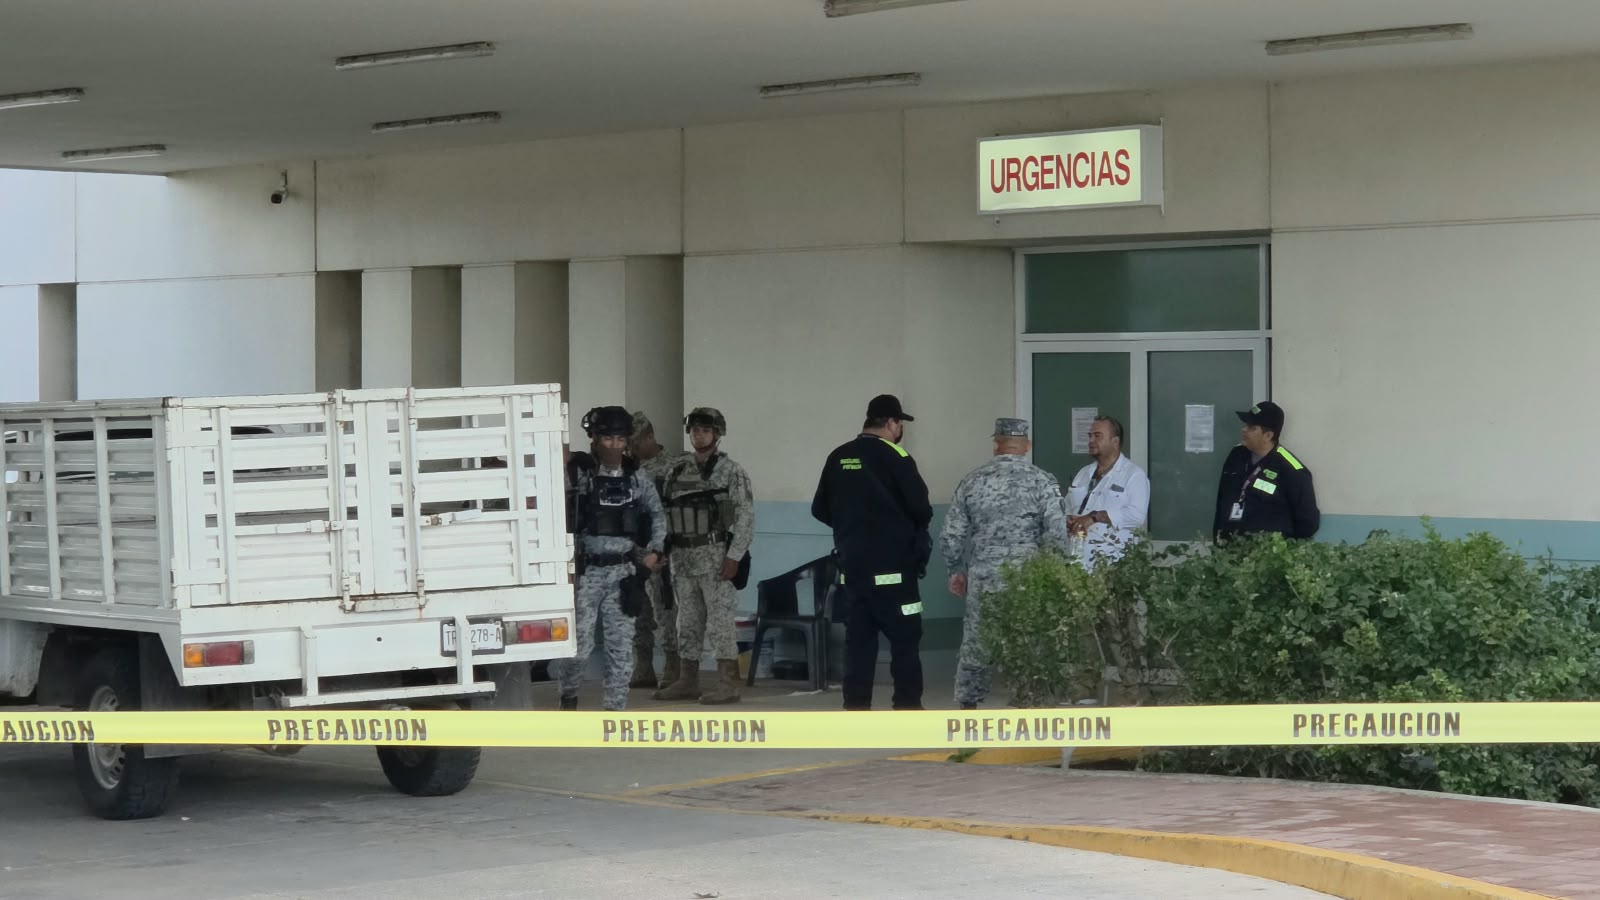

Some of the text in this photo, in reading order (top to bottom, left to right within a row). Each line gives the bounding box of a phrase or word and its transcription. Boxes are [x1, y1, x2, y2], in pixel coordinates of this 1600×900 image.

[990, 149, 1131, 193] URGENCIAS
[3, 711, 1461, 742] AUCION PRECAUCION PRECAUCION PRECAUCION PRECAUCION
